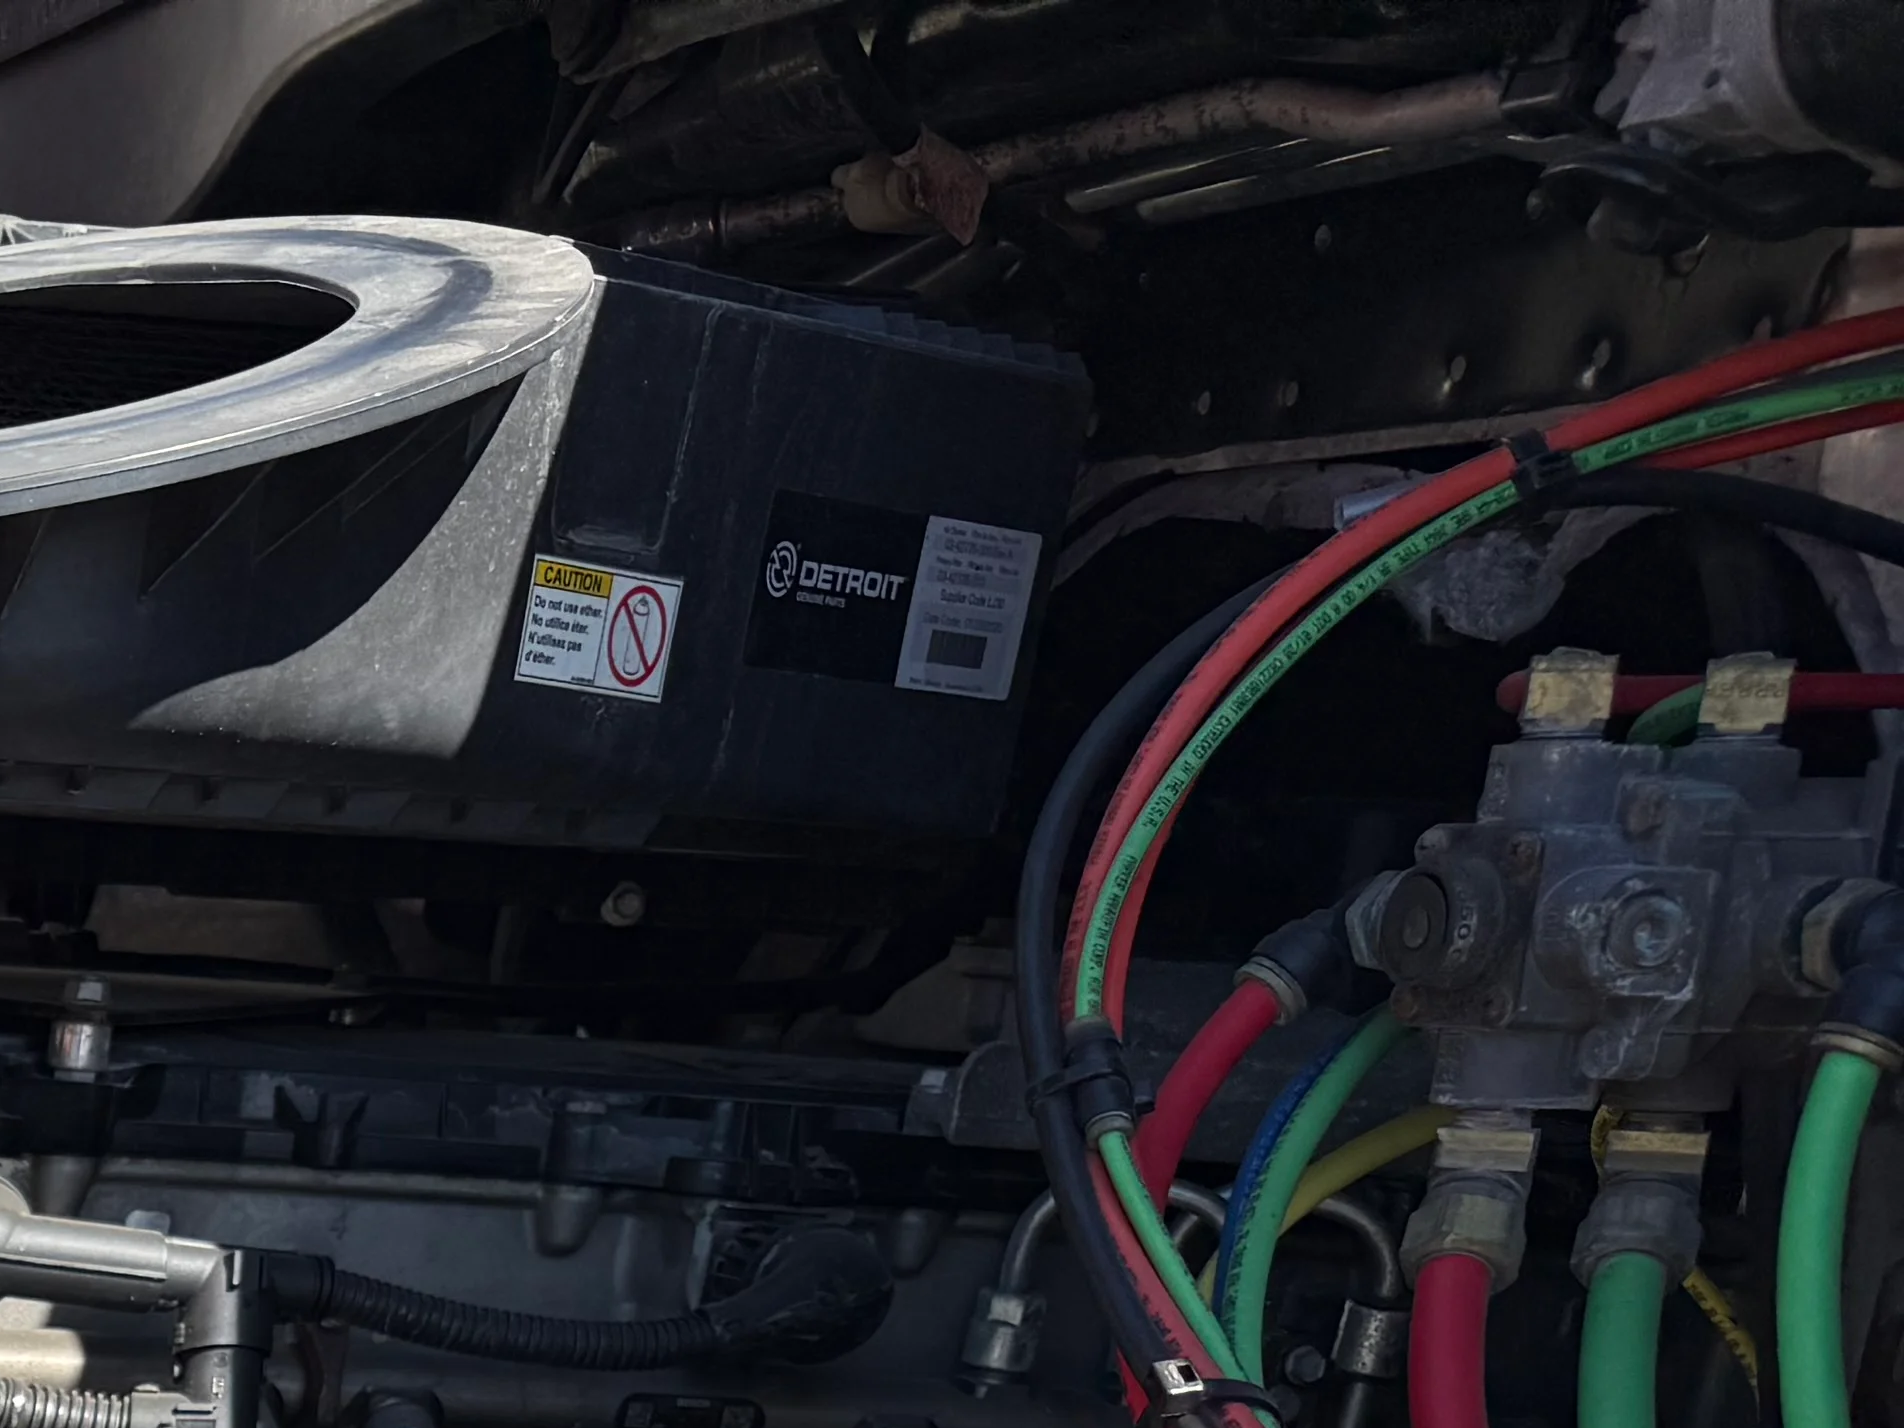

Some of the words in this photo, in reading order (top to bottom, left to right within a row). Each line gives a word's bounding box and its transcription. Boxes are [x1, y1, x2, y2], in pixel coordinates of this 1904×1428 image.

[543, 566, 603, 593] CAUTION
[799, 560, 906, 600] DETROIT
[534, 595, 546, 609] Do
[547, 598, 562, 611] not
[563, 601, 578, 614] use
[531, 613, 543, 627] No
